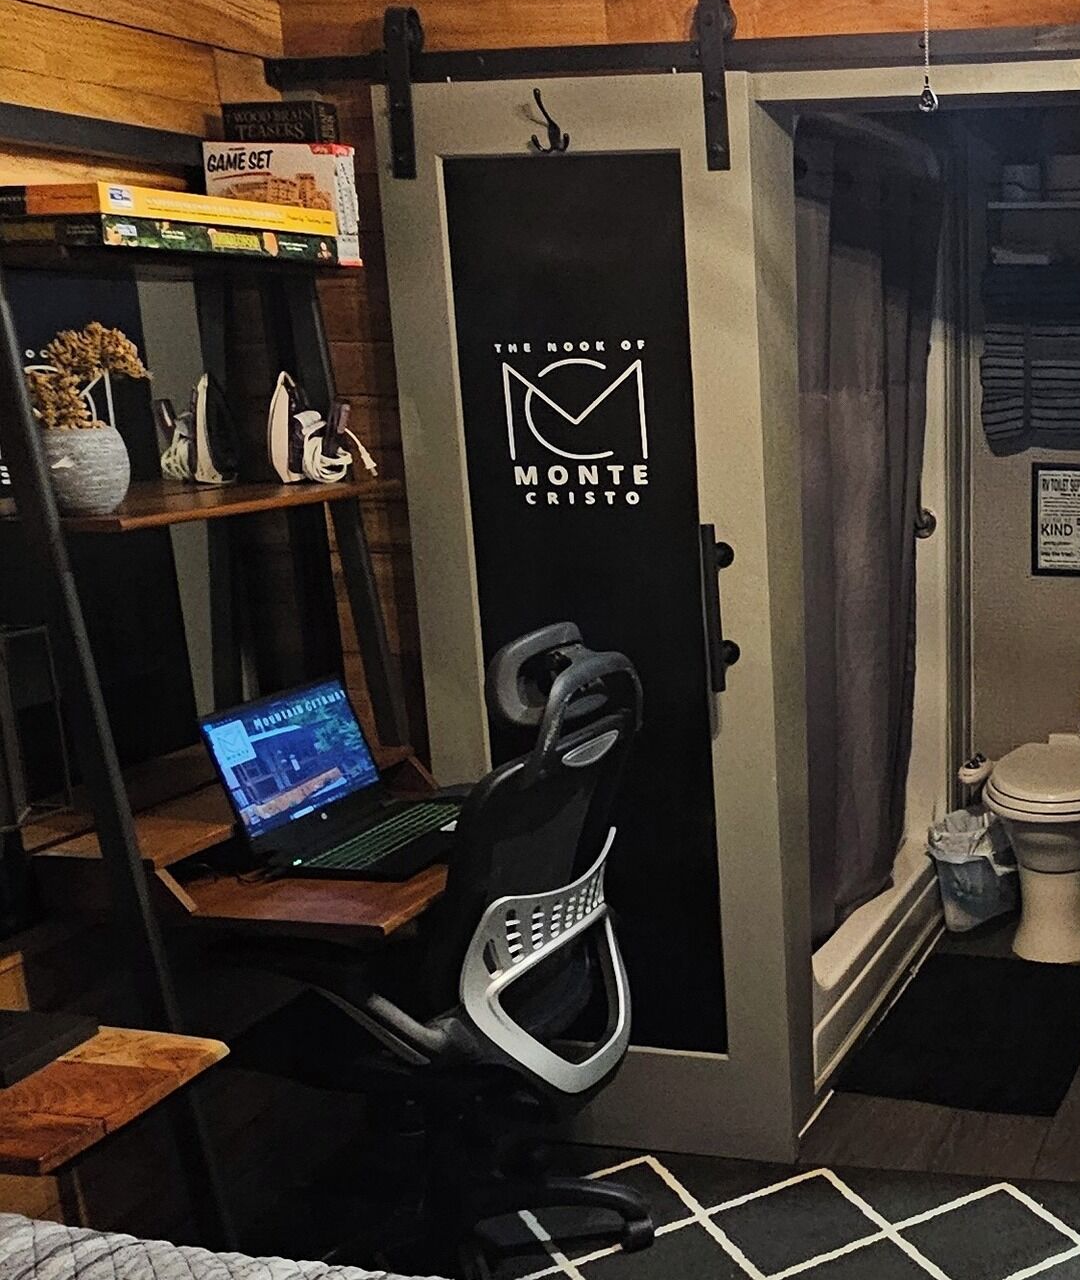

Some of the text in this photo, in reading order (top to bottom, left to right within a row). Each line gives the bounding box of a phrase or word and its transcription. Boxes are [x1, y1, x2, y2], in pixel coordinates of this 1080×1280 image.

[233, 110, 271, 122] WOOD
[235, 122, 305, 140] TEASERS
[207, 150, 274, 172] GAME SET
[494, 339, 645, 354] THE NOOK OF
[513, 464, 649, 486] MONTE
[1042, 478, 1050, 492] RV
[1051, 478, 1069, 493] TOILET
[525, 491, 641, 505] CRISTO
[1041, 523, 1074, 537] KIND
